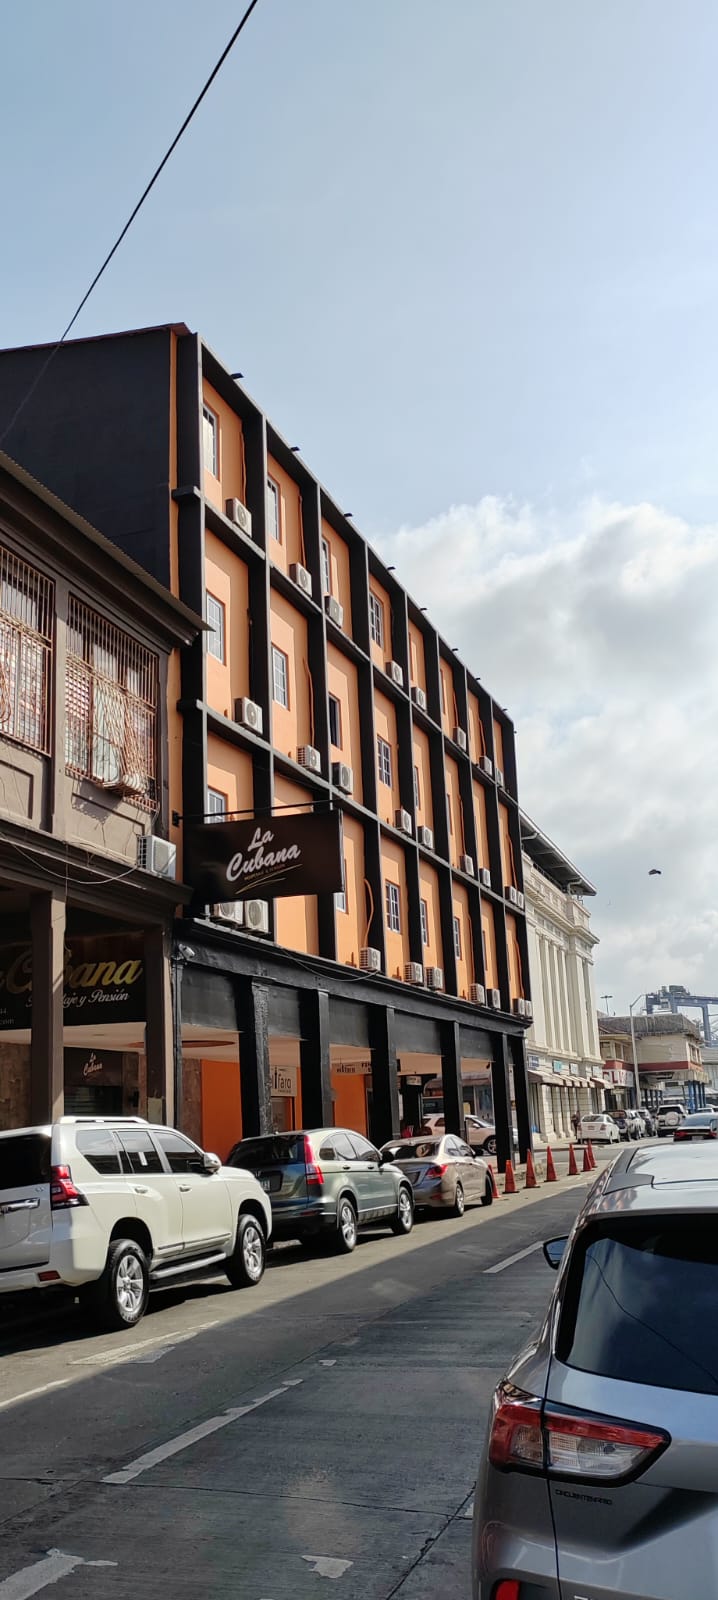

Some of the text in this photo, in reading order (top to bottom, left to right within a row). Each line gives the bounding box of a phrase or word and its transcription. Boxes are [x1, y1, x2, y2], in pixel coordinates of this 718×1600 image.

[248, 827, 275, 852] La
[226, 844, 301, 882] Cubana
[88, 987, 129, 1003] Pensión
